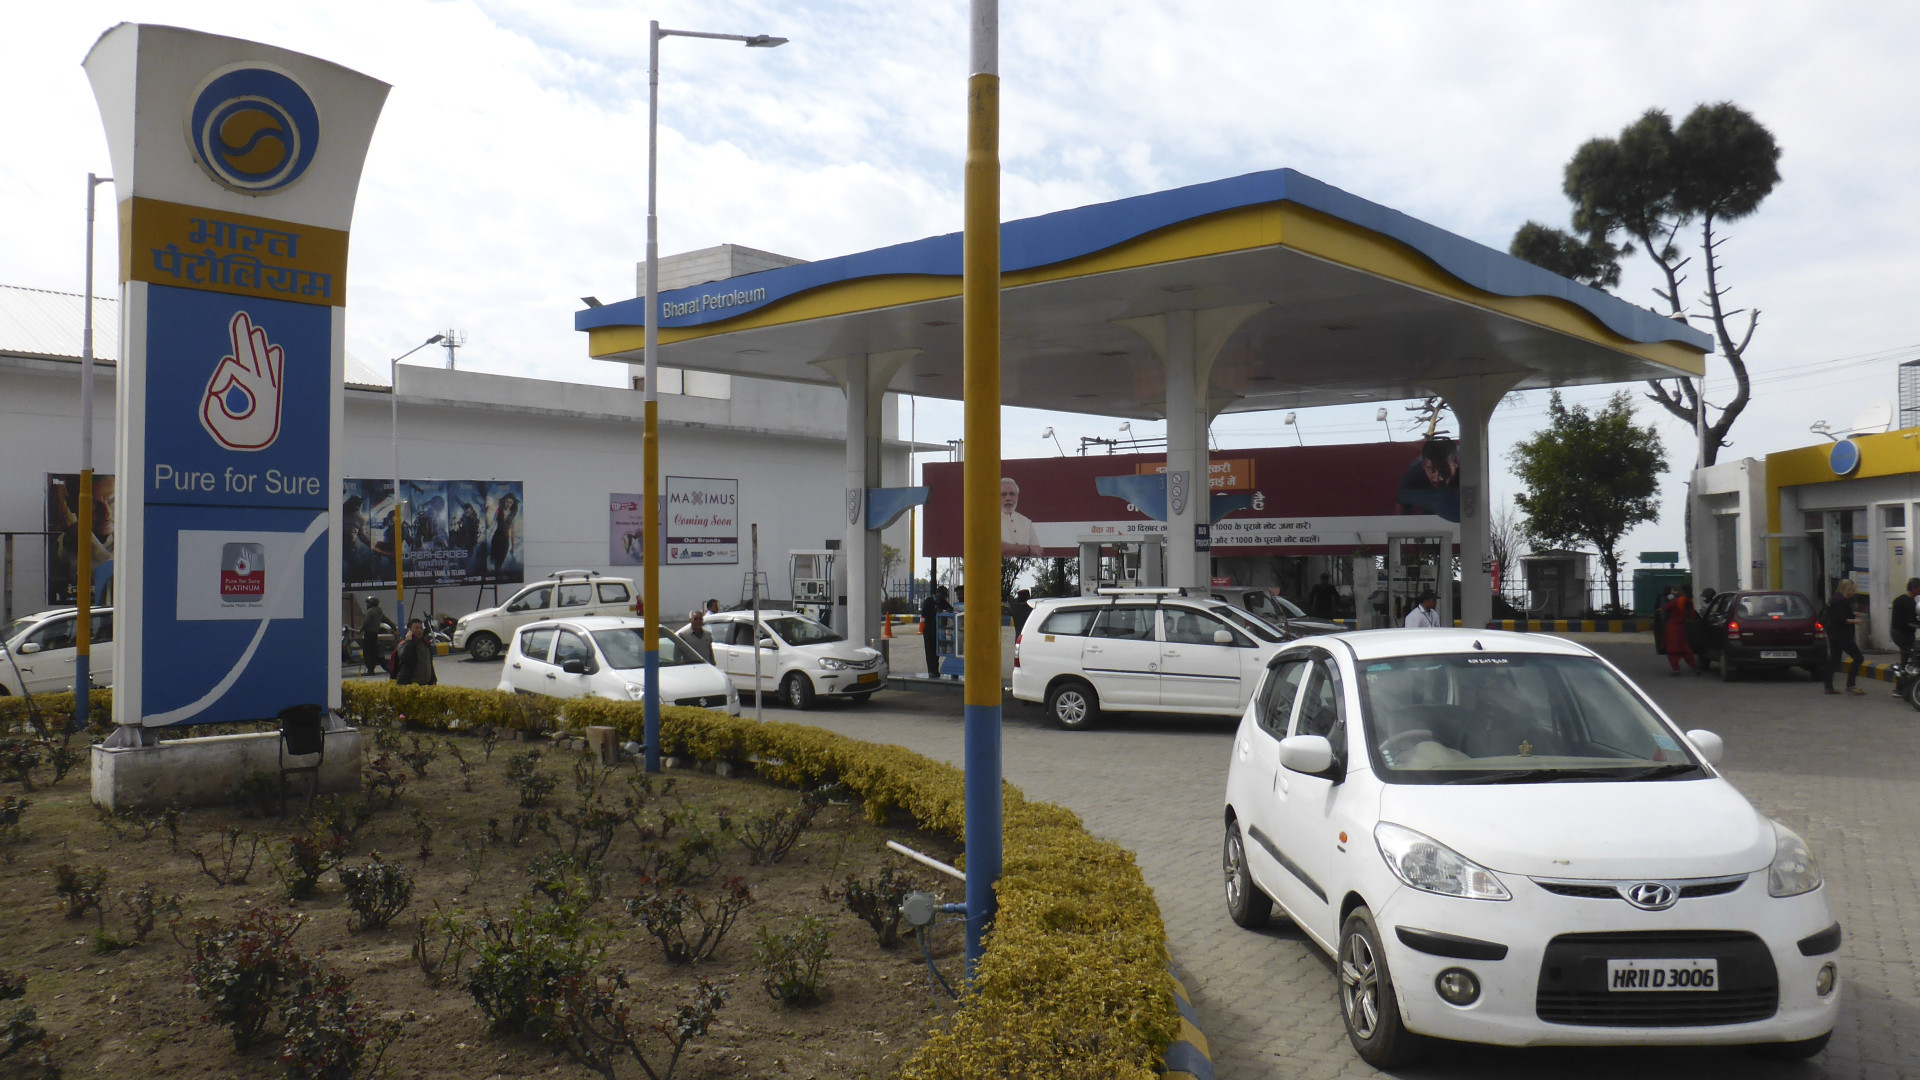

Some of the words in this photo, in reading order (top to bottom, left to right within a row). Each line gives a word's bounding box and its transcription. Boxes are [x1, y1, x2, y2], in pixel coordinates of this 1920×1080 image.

[188, 217, 300, 259] भारत
[663, 298, 701, 319] Bharat
[702, 287, 766, 311] Petroleum
[155, 464, 216, 492] Pure
[224, 467, 257, 492] for
[265, 469, 320, 495] Sure
[670, 491, 735, 506] MAXIMUS
[1252, 491, 1266, 511] है
[674, 513, 708, 528] Coming
[710, 513, 732, 526] Soon
[1234, 522, 1242, 530] के
[1263, 520, 1276, 530] नोट
[1254, 535, 1262, 543] के
[1284, 534, 1297, 543] नोट
[1652, 969, 1665, 988] D
[1667, 969, 1714, 987] 3006
